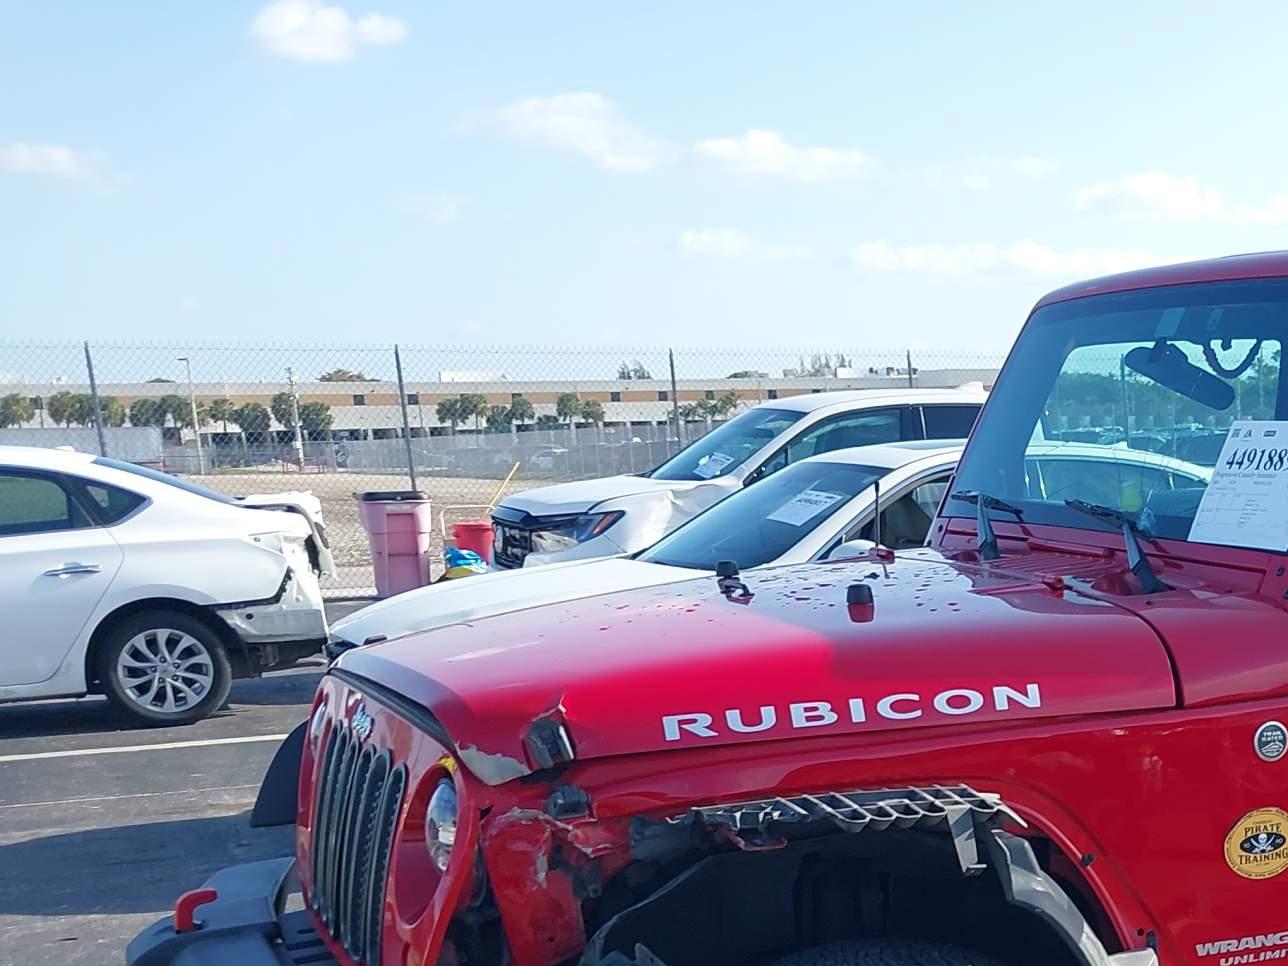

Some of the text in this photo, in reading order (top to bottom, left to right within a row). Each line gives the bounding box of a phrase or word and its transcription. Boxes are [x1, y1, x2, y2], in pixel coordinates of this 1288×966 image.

[661, 683, 1042, 741] RUBICON
[1244, 822, 1282, 837] PIRATE
[1238, 847, 1288, 865] TRAINING
